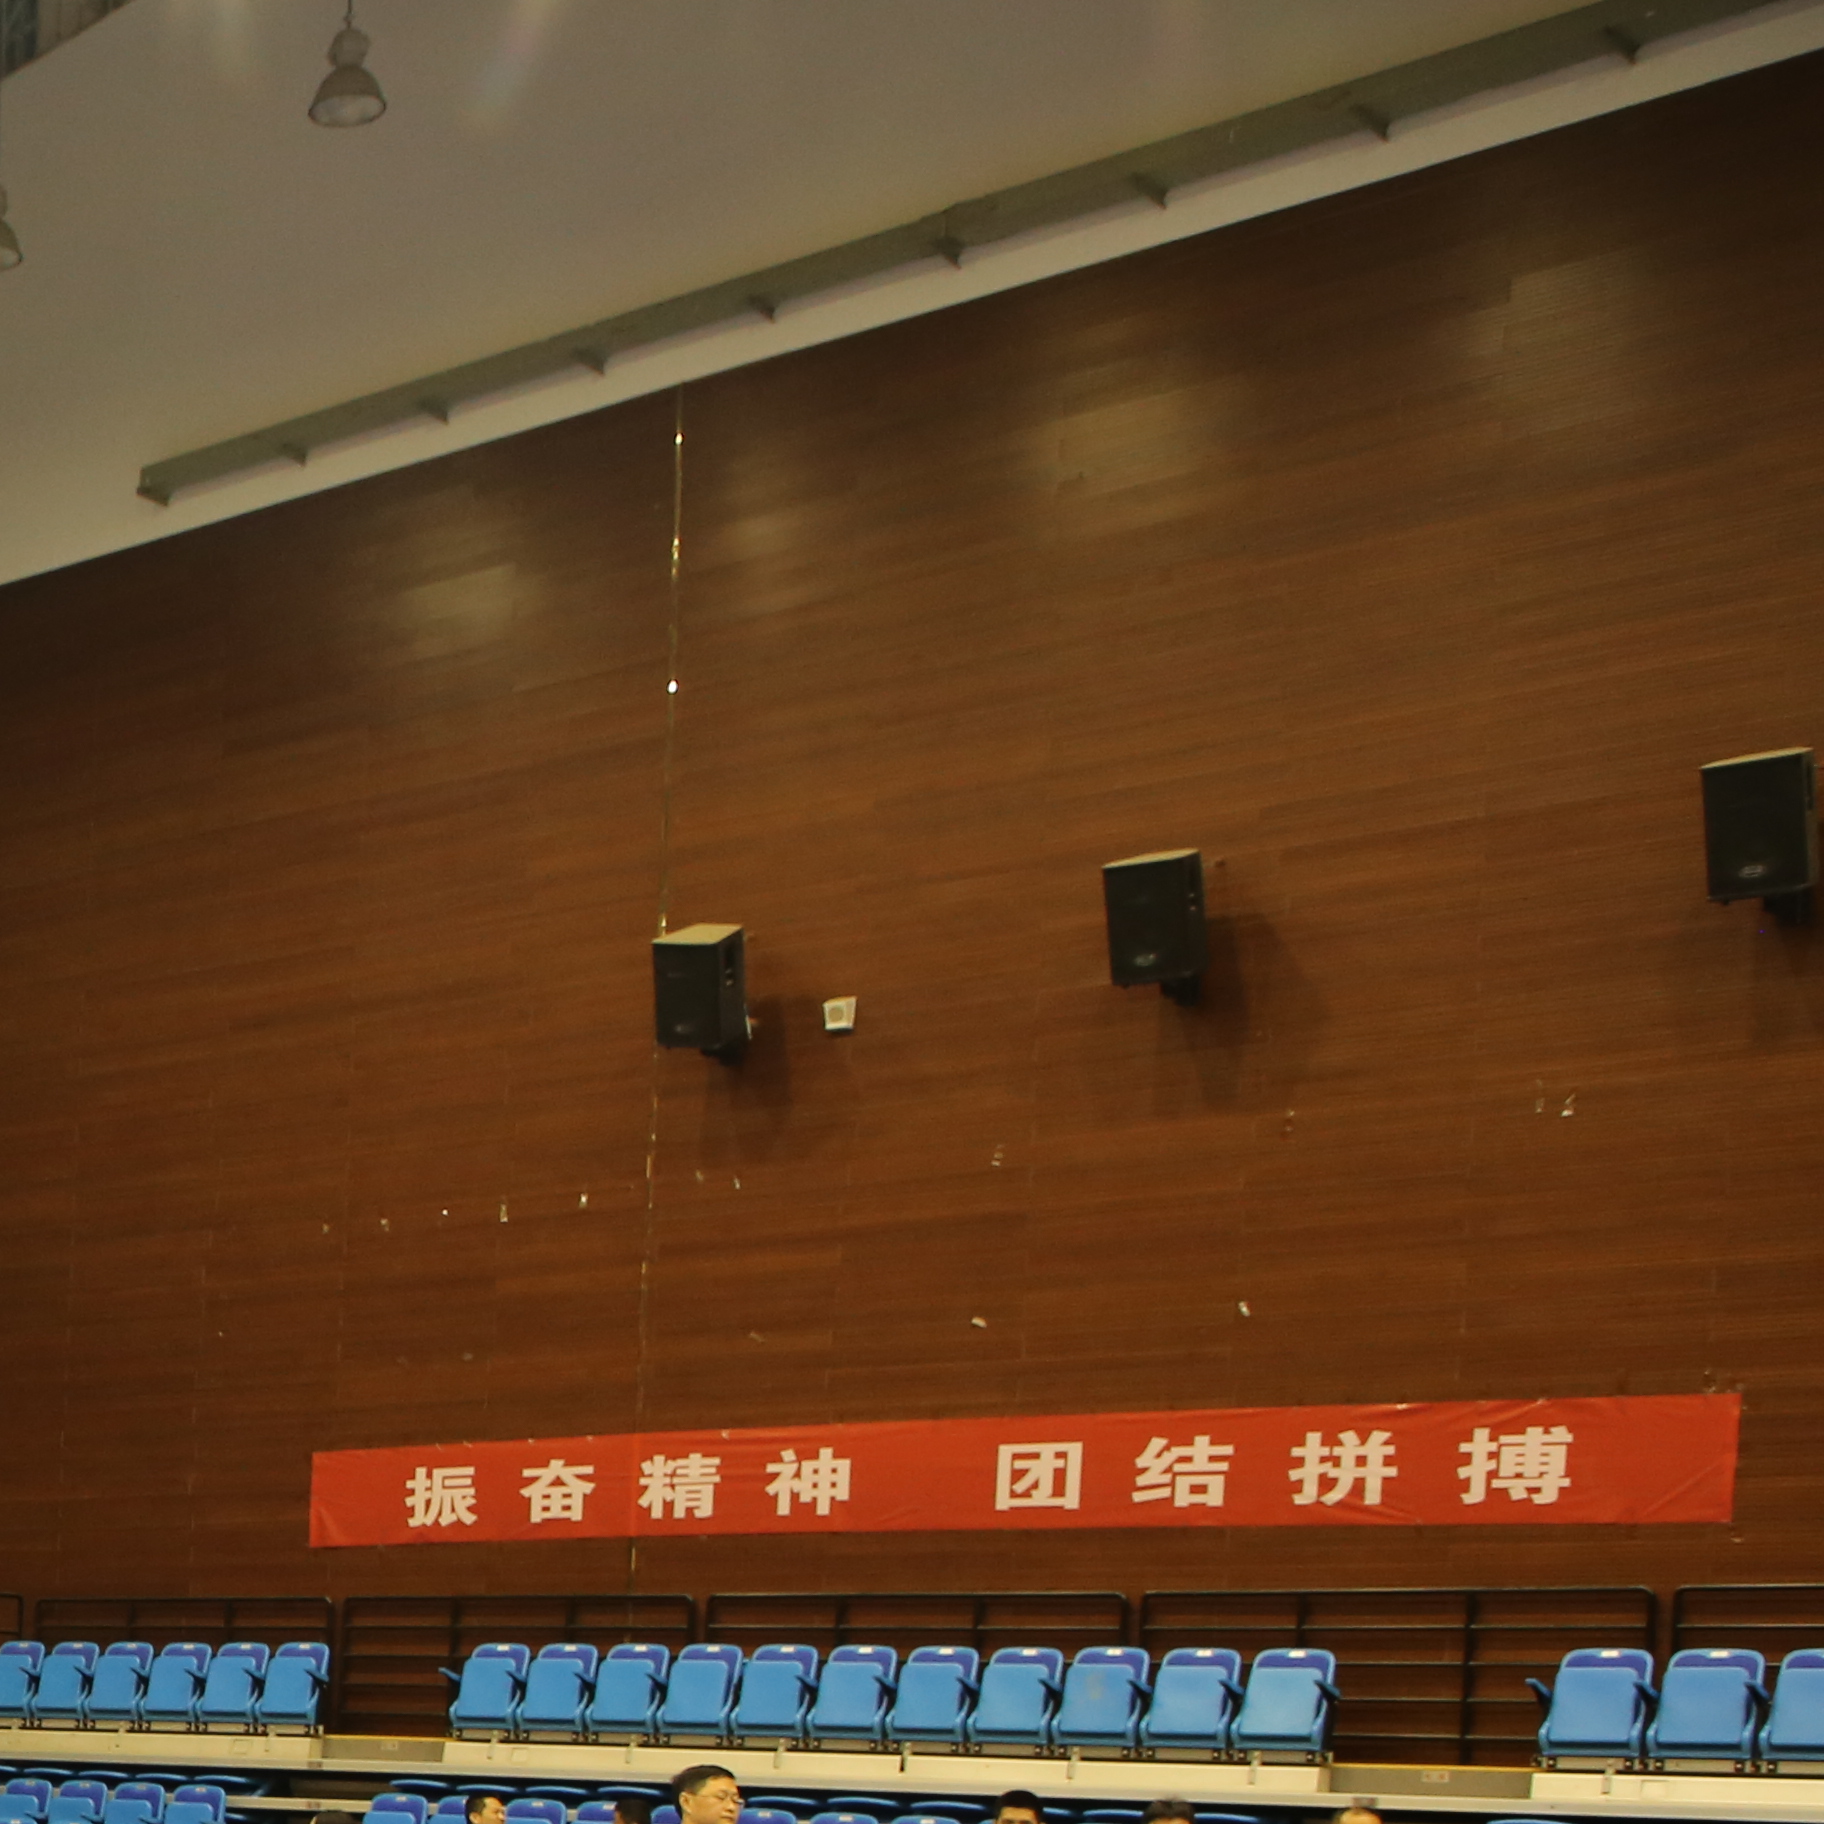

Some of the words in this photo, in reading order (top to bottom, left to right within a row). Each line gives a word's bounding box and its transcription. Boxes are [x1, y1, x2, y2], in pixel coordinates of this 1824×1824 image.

[405, 1447, 851, 1527] 振奋精神
[994, 1426, 1573, 1510] 团结拼搏
